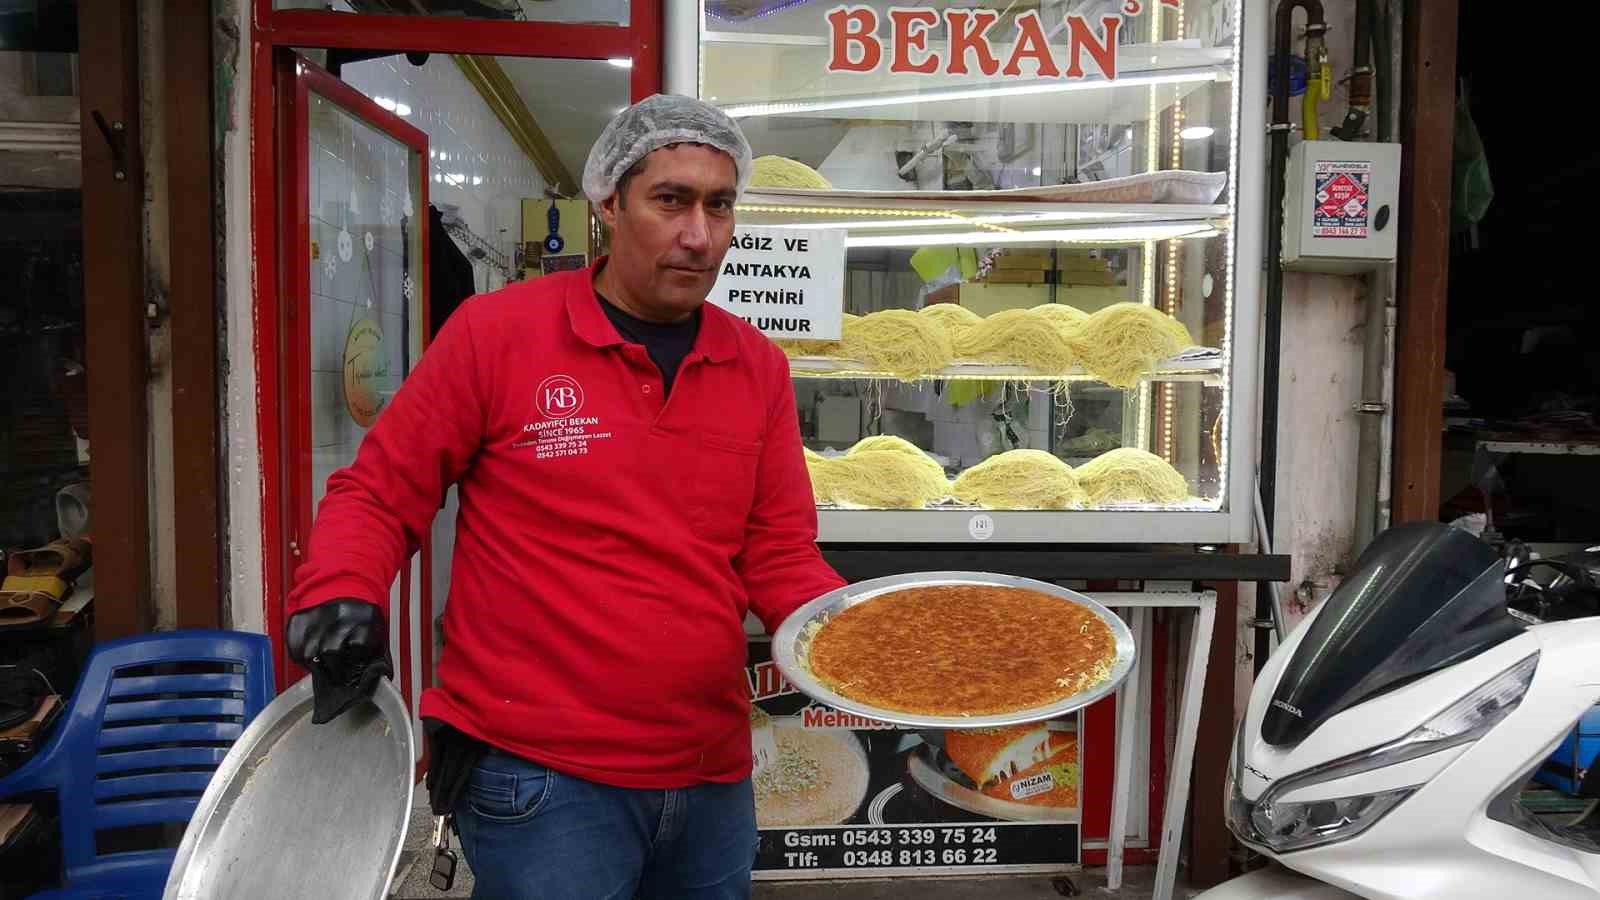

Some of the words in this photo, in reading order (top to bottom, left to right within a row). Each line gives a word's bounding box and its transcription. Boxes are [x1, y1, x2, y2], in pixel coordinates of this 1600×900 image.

[827, 6, 1121, 80] BEKAN
[784, 238, 809, 252] VE
[723, 263, 811, 279] ANTAKYA
[728, 288, 804, 305] PEYNİRİ
[545, 386, 577, 410] KB
[569, 417, 599, 425] BEKAN
[565, 426, 585, 435] 1965
[536, 444, 554, 452] 0543
[803, 709, 884, 727] Mehme
[784, 832, 836, 847] Gsm:
[842, 830, 892, 845] 0543
[898, 829, 935, 845] 339
[941, 828, 966, 844] 75
[971, 827, 997, 843] 24
[784, 852, 819, 867] Tlf:
[843, 850, 893, 866] 0348
[899, 849, 936, 865] 813
[942, 848, 967, 864] 66
[972, 848, 998, 863] 22
